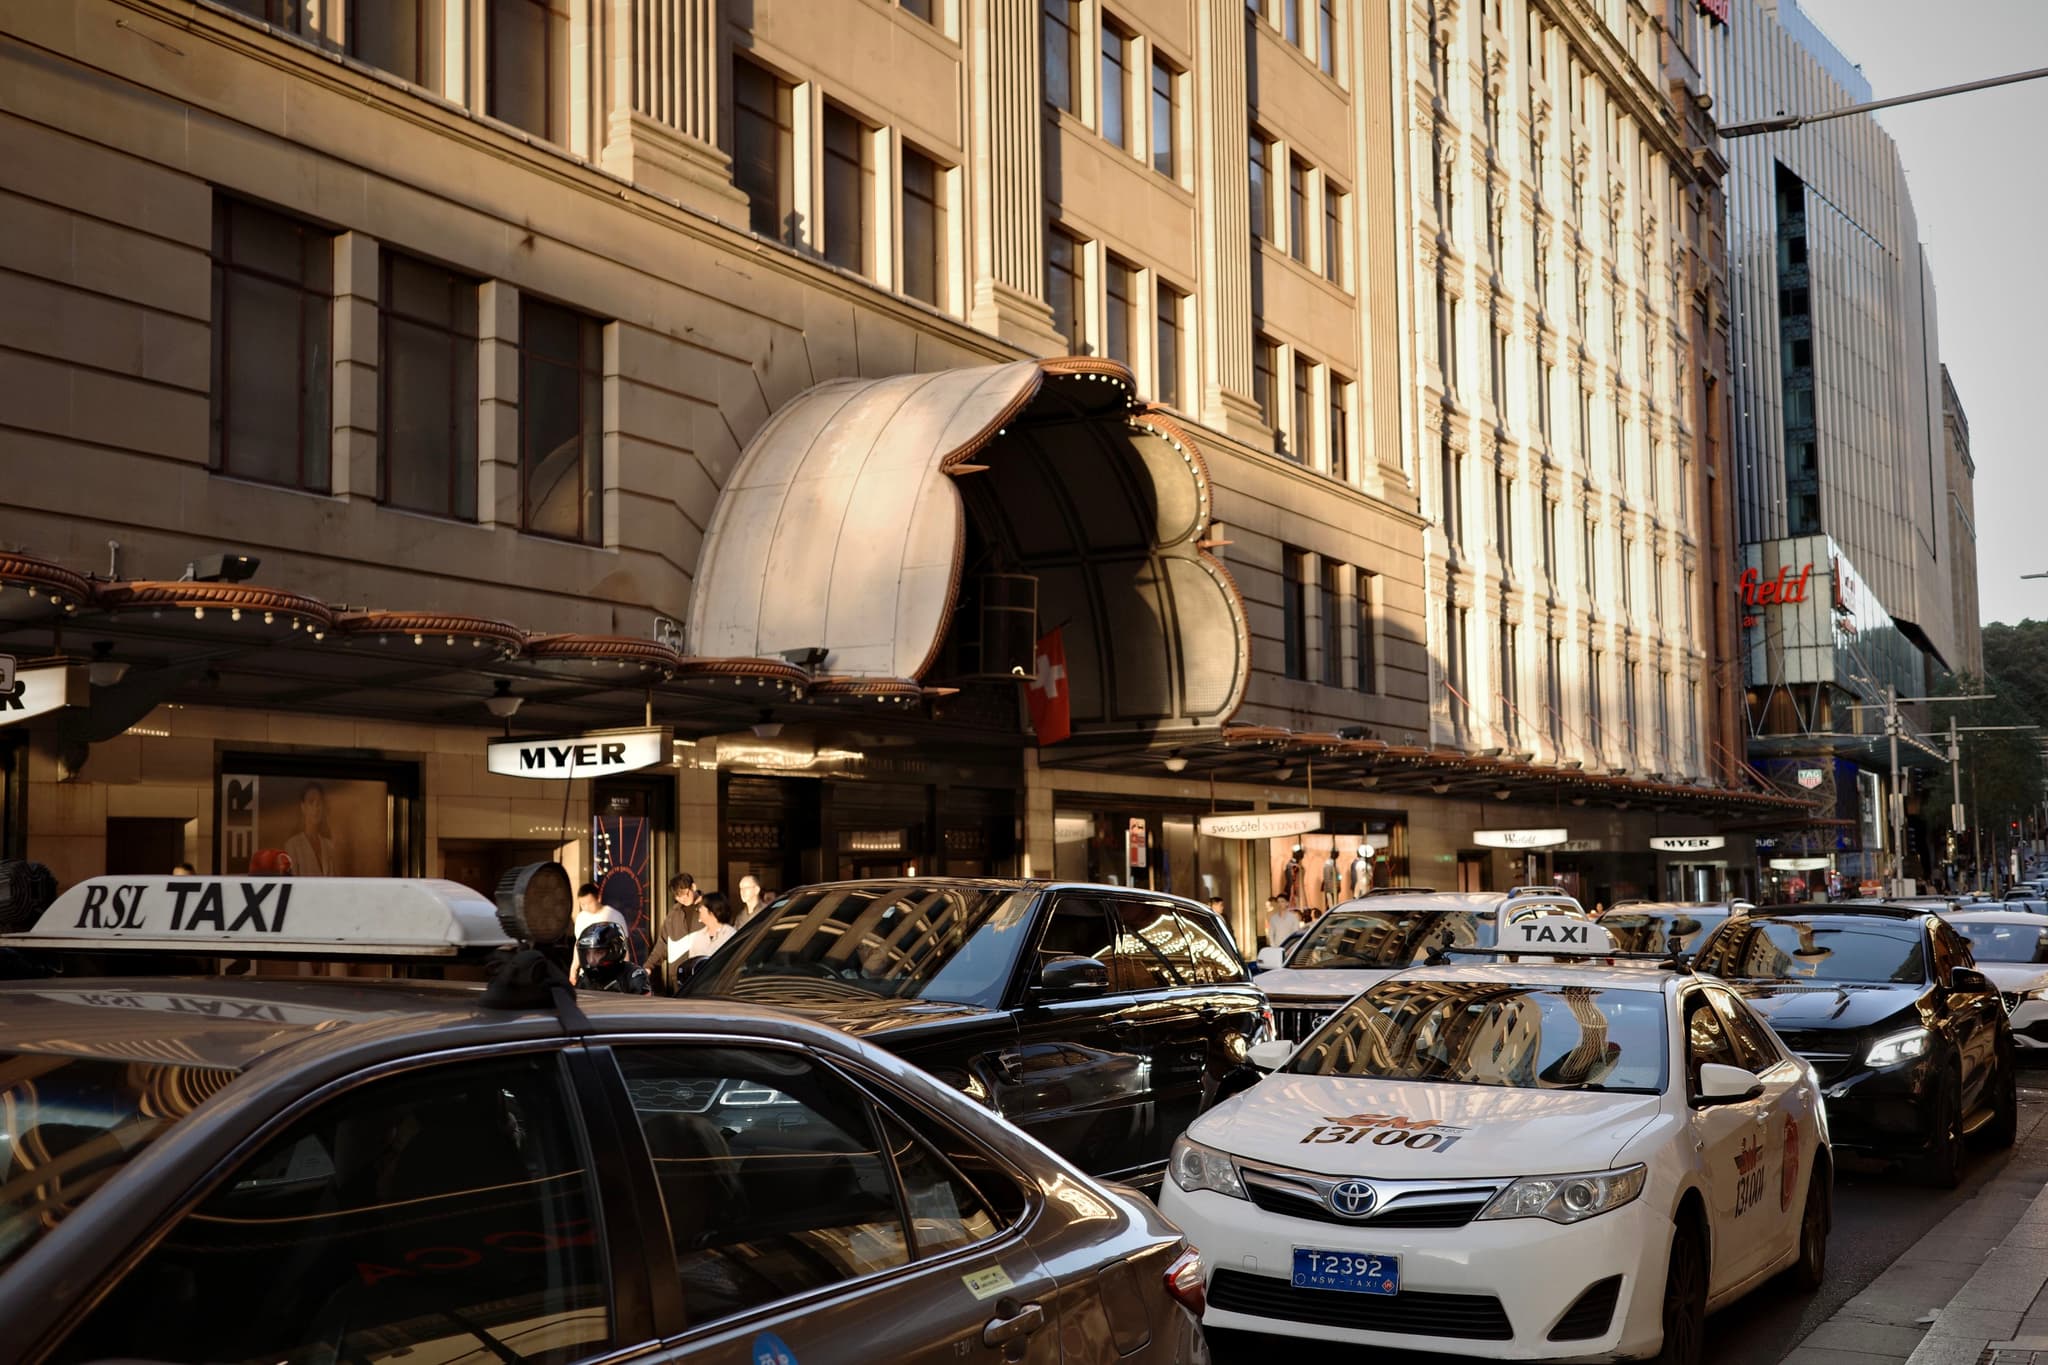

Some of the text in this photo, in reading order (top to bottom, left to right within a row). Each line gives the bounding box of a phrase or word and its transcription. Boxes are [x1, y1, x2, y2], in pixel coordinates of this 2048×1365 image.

[519, 743, 626, 770] MYER
[1663, 839, 1710, 848] MYER
[74, 882, 293, 932] RSL TAXI
[1521, 925, 1588, 943] TAXI
